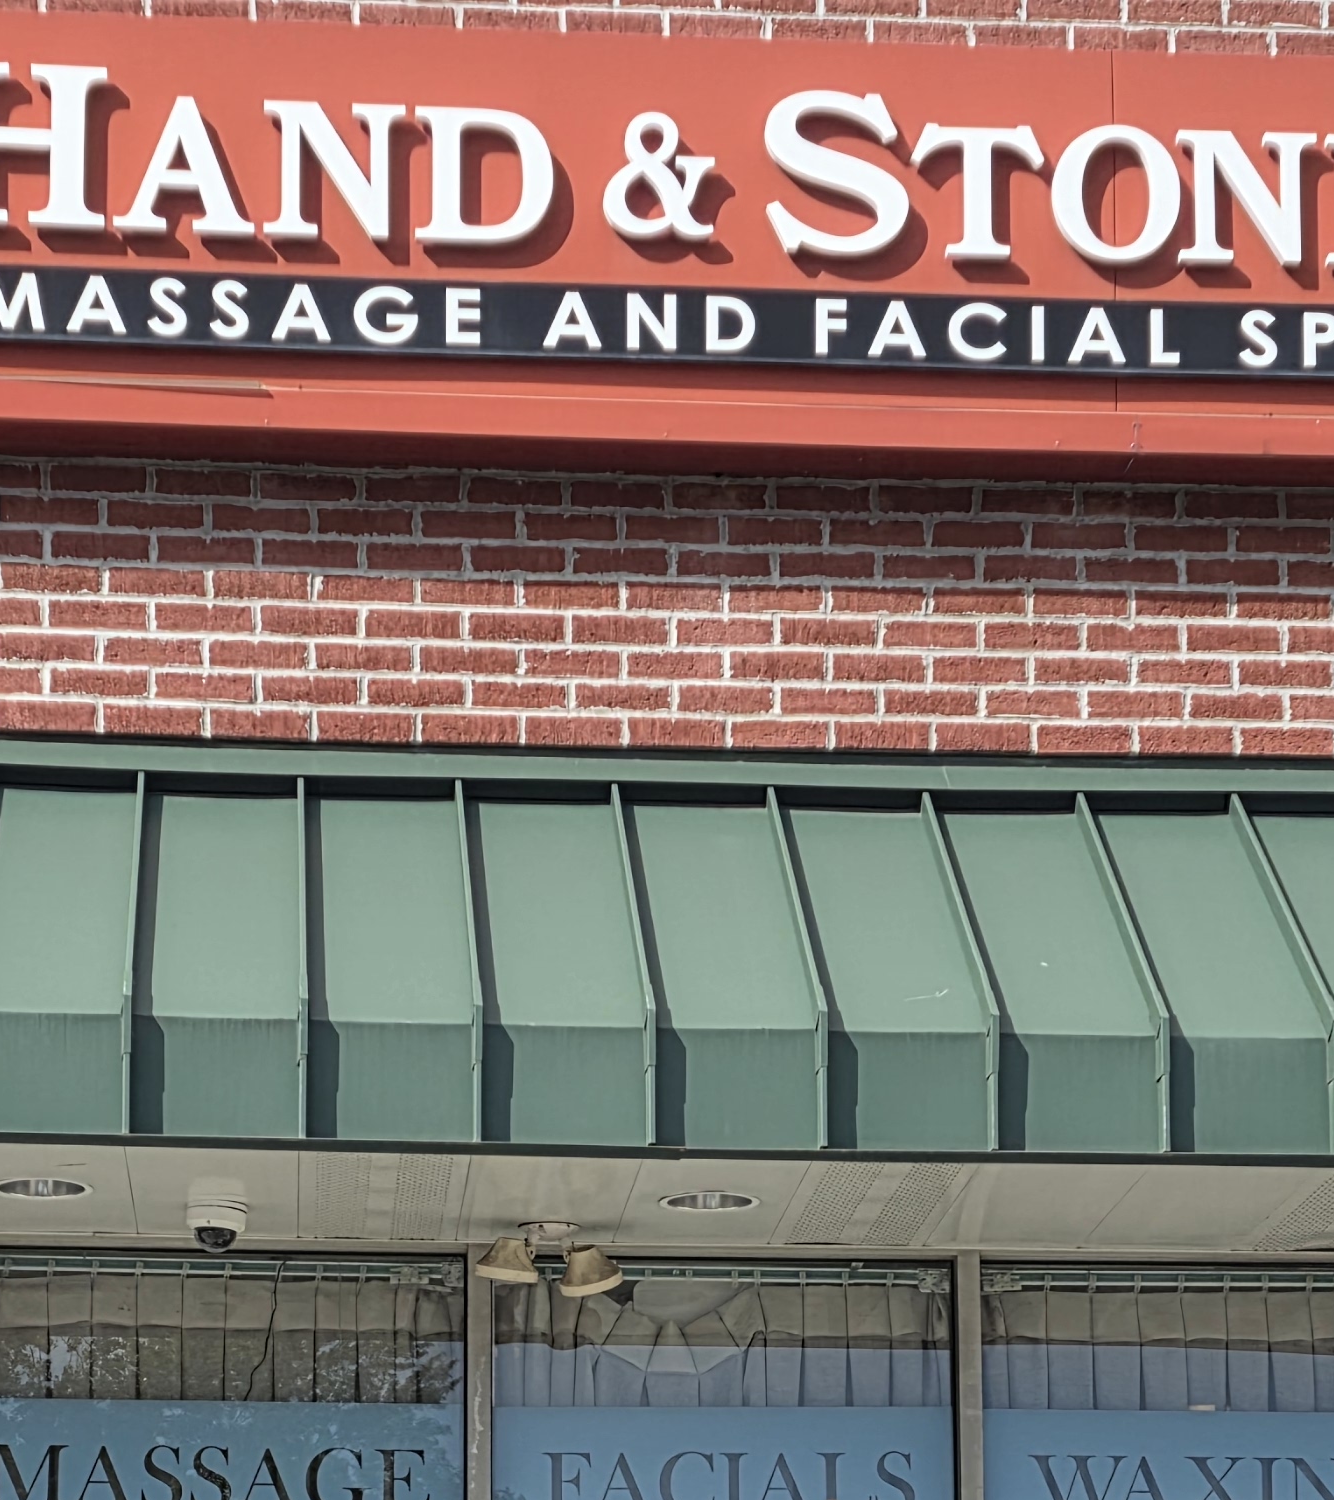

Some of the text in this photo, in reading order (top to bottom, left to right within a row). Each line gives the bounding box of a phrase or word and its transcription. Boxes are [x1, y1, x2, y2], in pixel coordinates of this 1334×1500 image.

[603, 110, 715, 240] &
[542, 290, 757, 354] AND
[813, 299, 1181, 366] FACIAL
